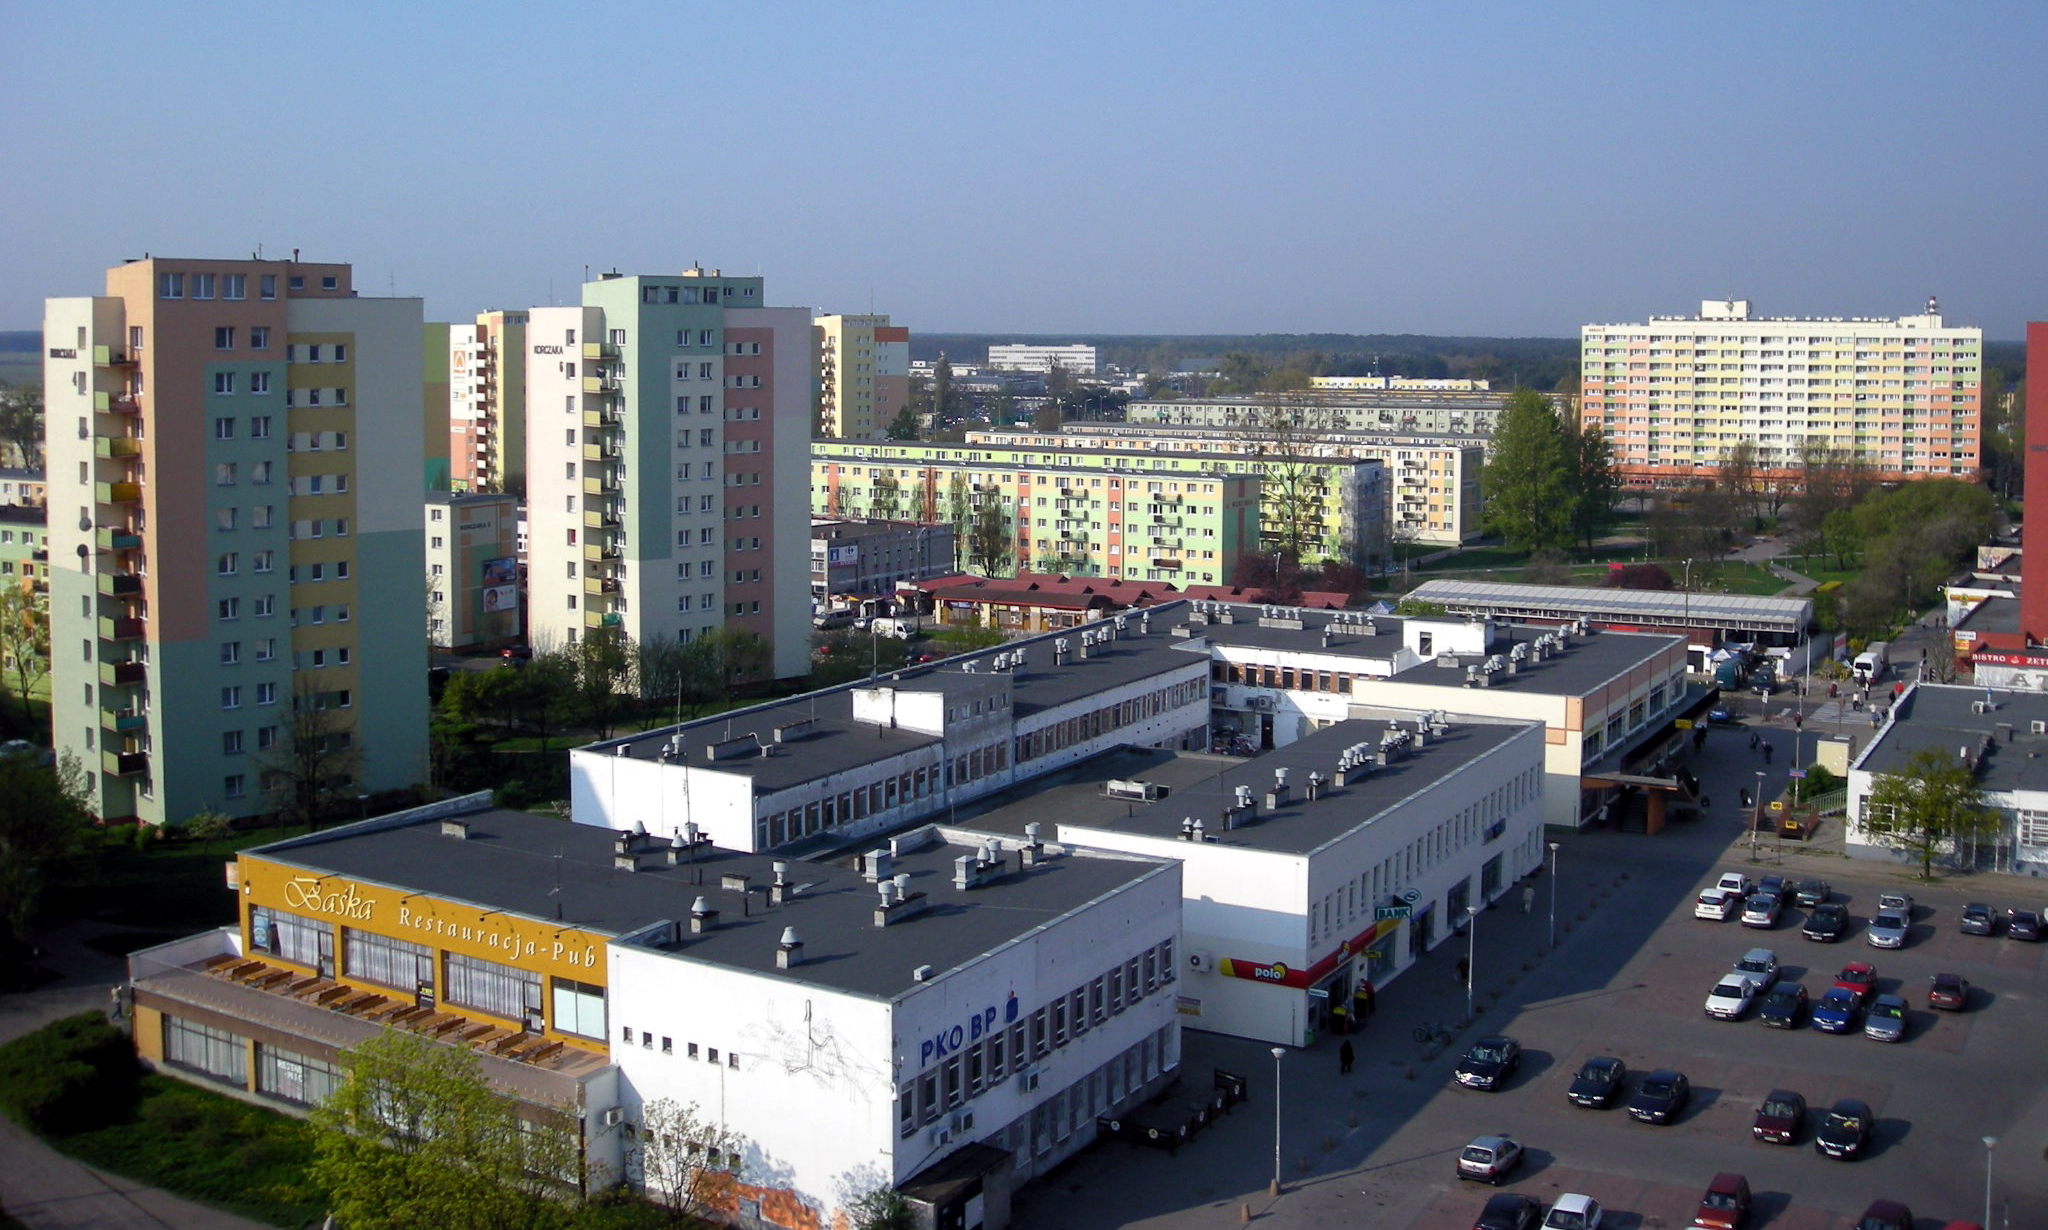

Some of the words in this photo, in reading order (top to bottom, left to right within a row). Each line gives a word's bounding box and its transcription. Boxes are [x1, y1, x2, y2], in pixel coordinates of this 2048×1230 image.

[1972, 654, 2006, 662] BISTRO
[1379, 908, 1408, 918] BANK
[1255, 967, 1281, 980] polo
[921, 1025, 964, 1068] PKO
[971, 1006, 997, 1040] BP
